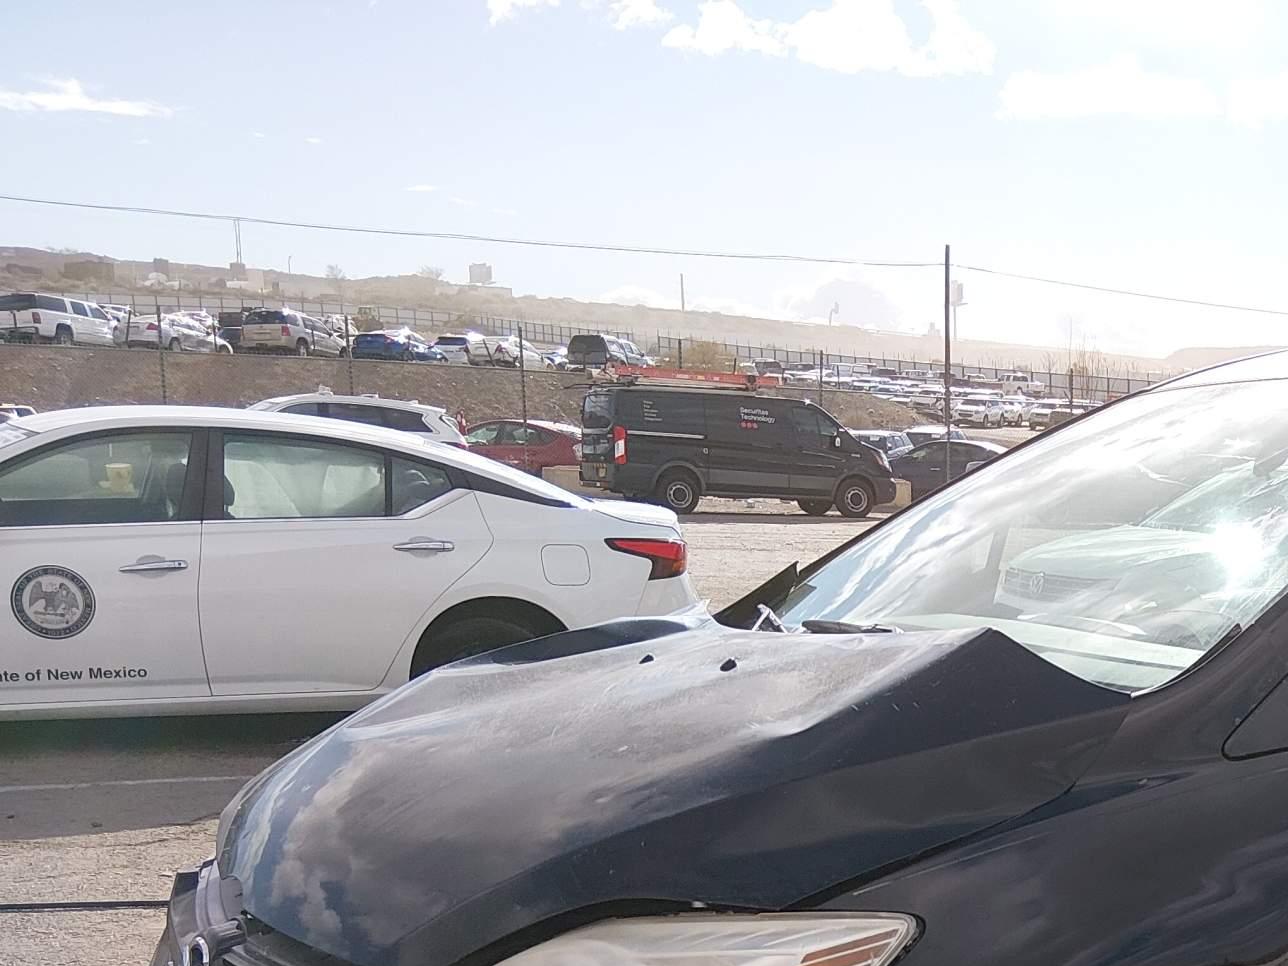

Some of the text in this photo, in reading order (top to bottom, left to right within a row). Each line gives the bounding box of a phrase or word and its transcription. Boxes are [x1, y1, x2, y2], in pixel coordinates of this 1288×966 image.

[740, 406, 769, 416] Securitas
[741, 413, 776, 424] Technology
[0, 666, 148, 682] te of New Mexico
